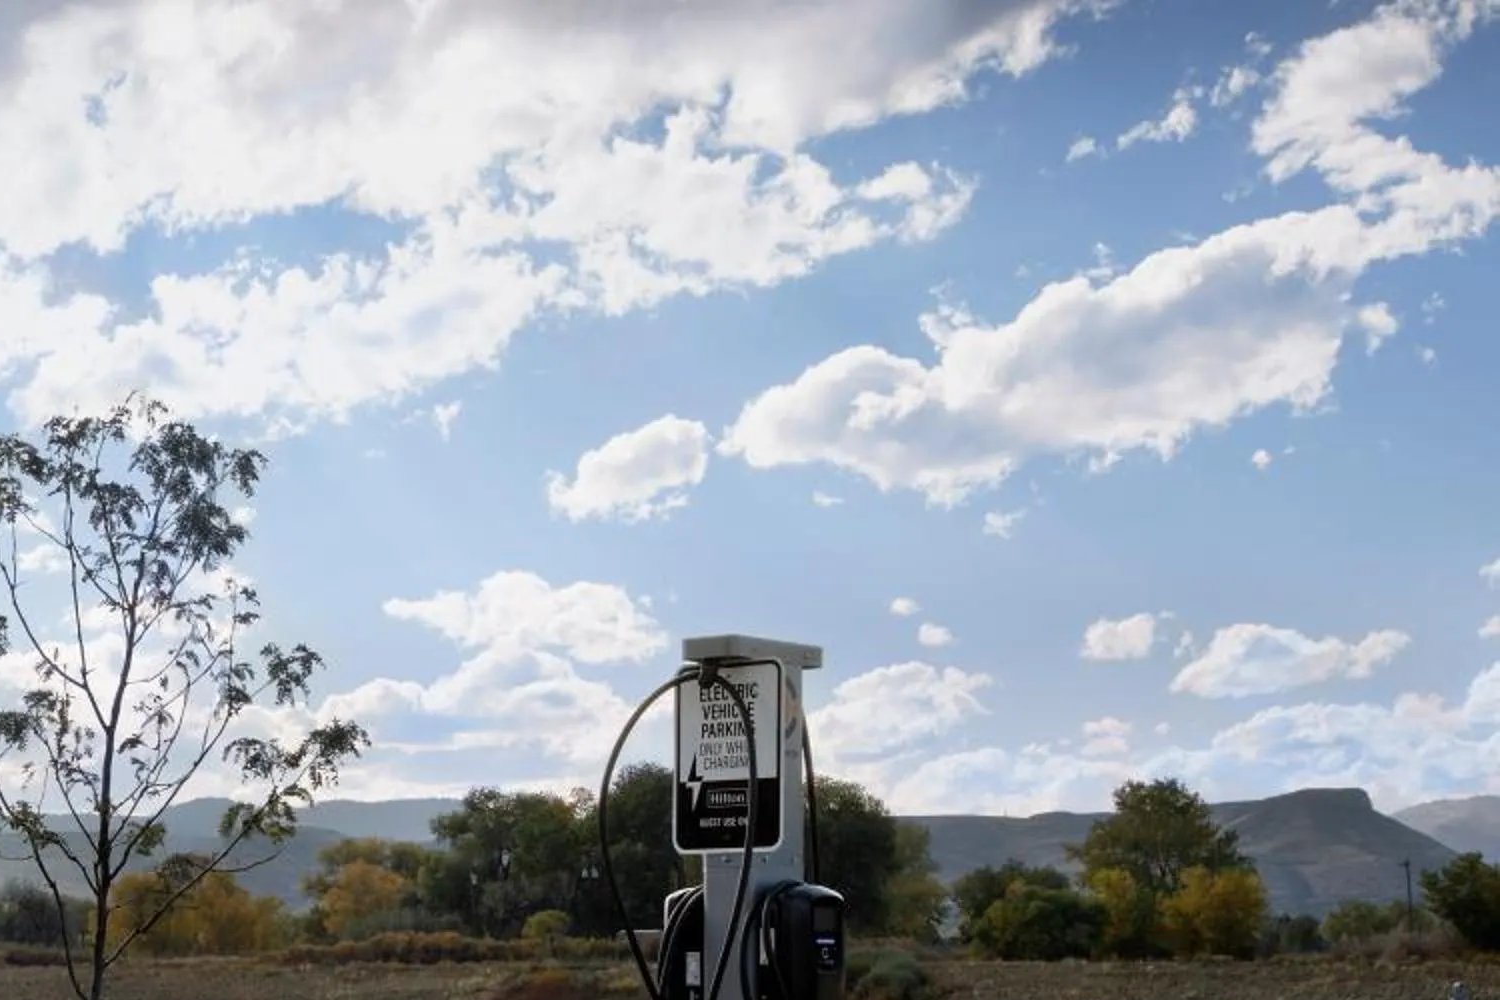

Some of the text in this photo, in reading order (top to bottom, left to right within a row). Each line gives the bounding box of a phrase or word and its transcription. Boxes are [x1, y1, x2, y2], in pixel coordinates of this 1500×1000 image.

[699, 682, 759, 702] ELECRIC
[701, 702, 756, 720] VEHICE
[701, 721, 755, 738] PARKIN
[703, 755, 750, 771] CHARGIN
